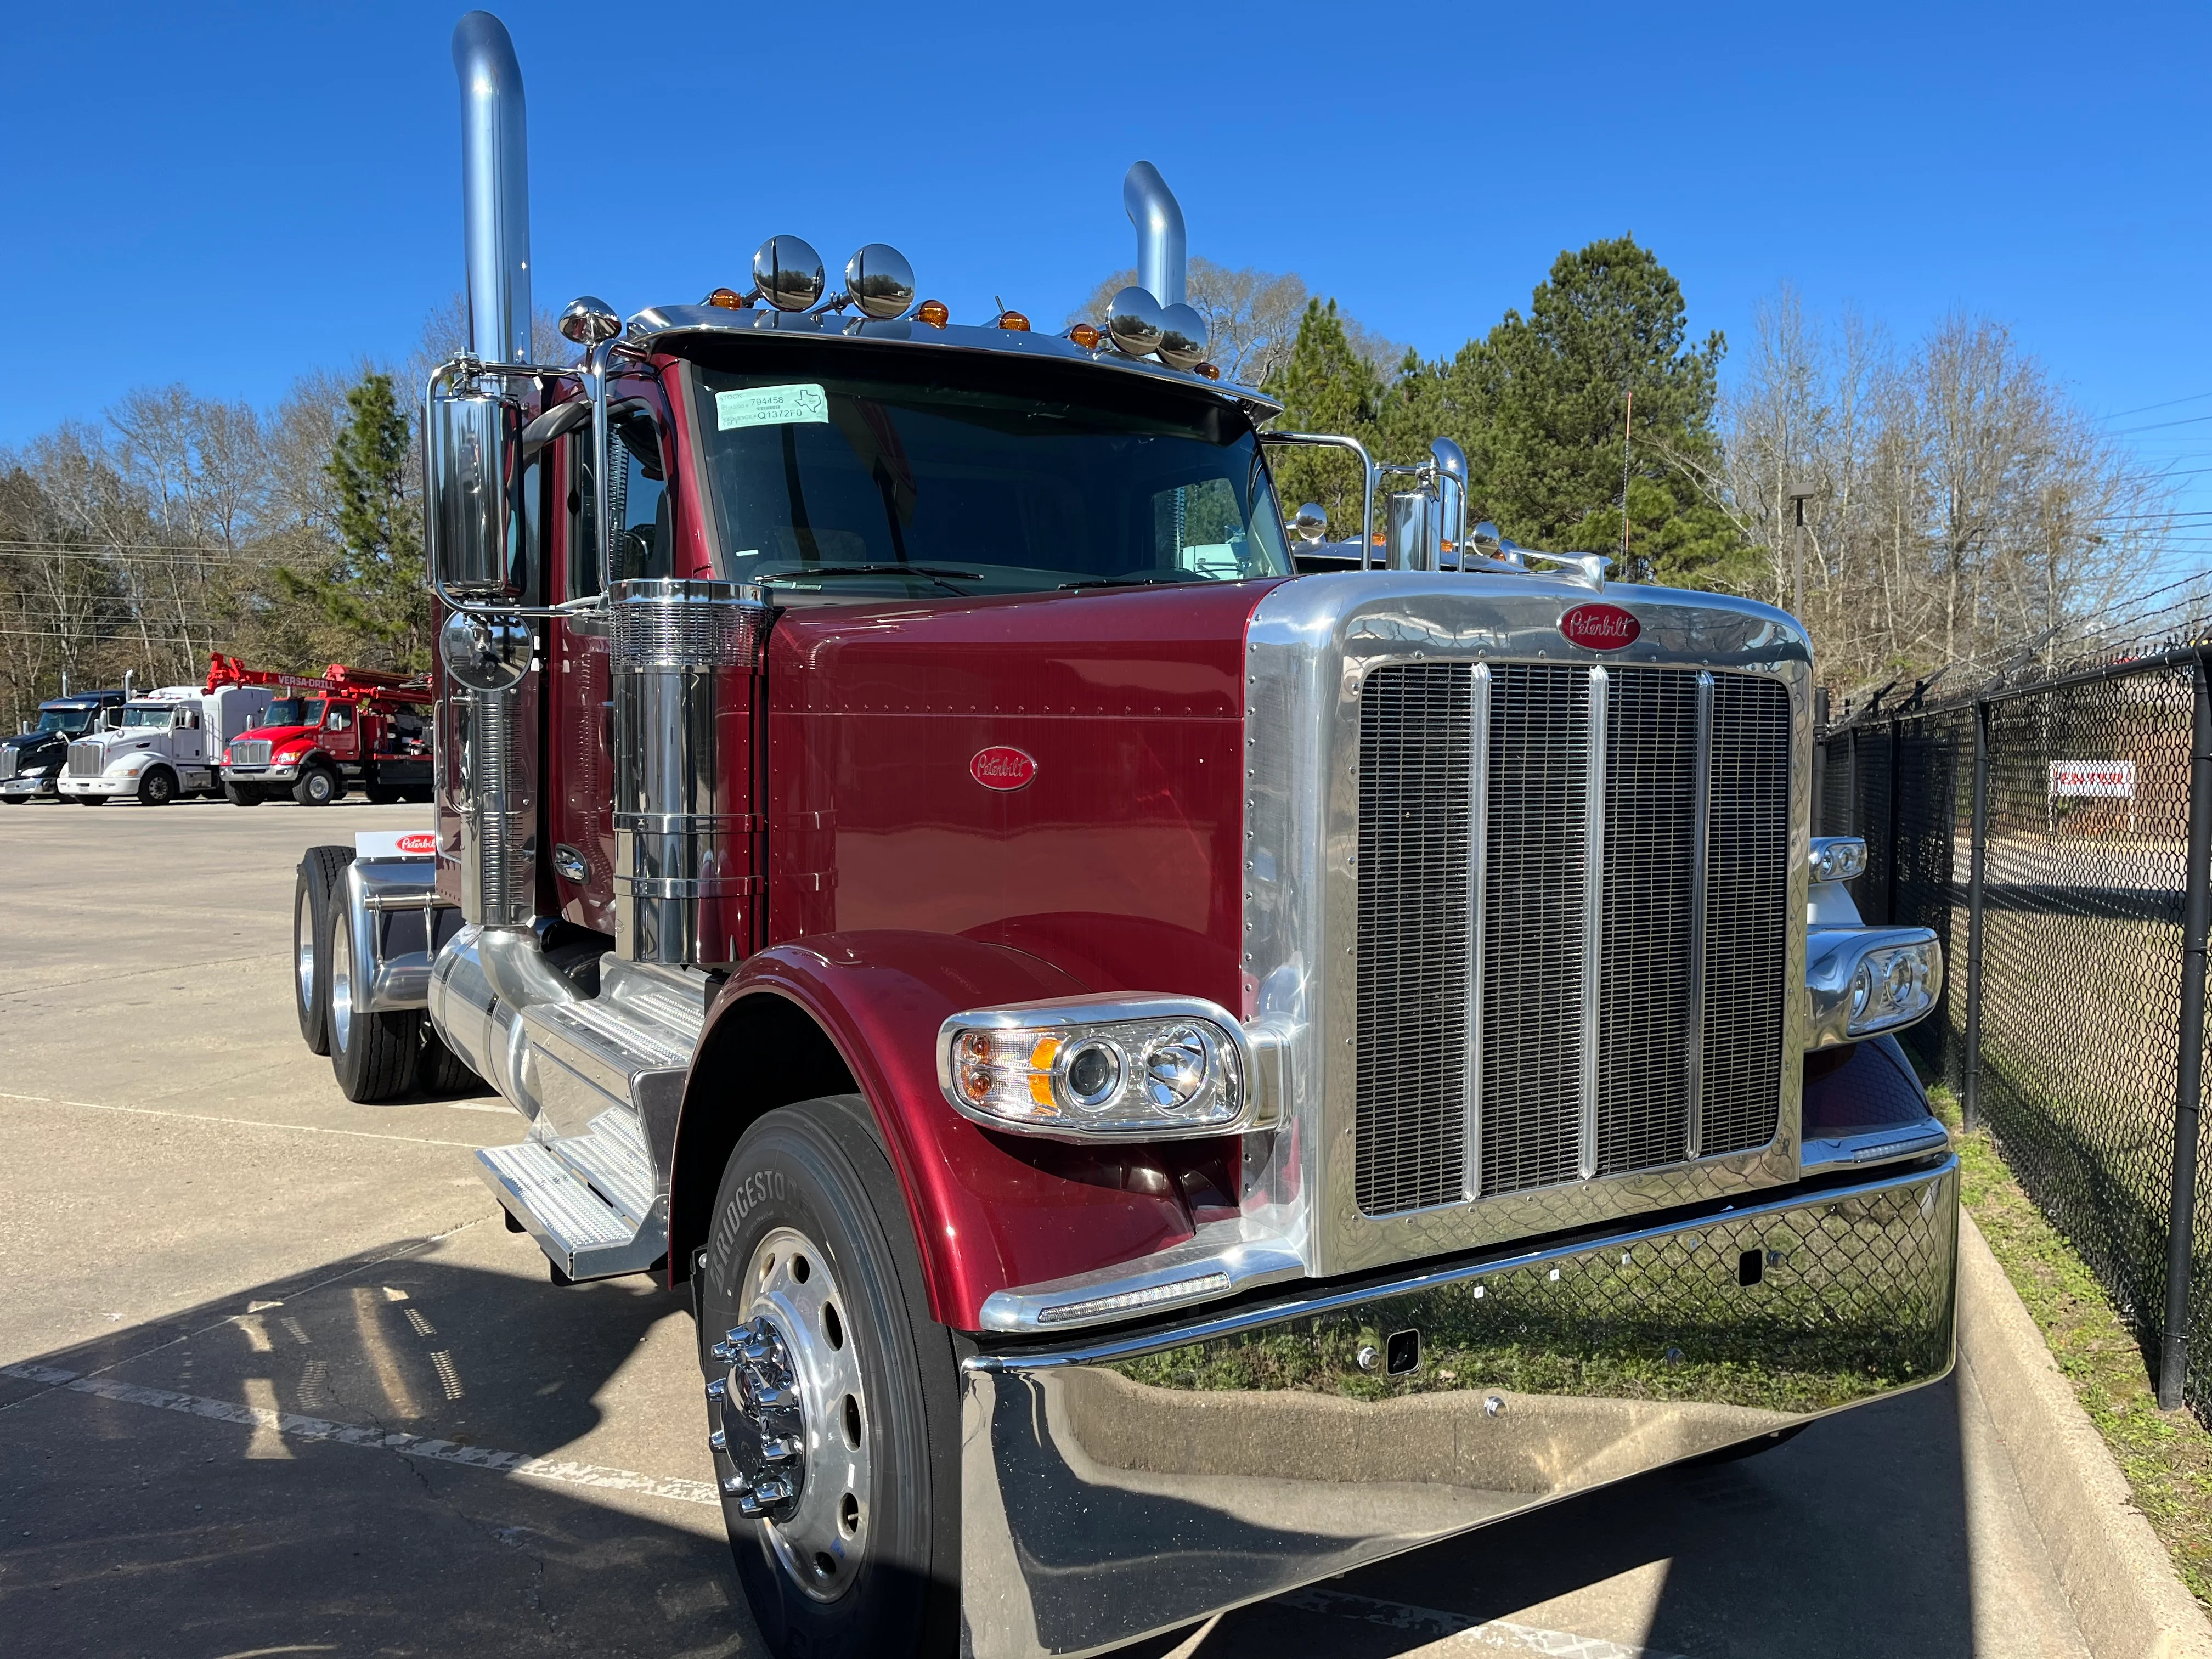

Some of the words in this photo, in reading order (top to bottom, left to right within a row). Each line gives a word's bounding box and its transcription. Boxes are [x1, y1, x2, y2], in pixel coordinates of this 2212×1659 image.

[751, 397, 784, 406] 794458
[758, 409, 802, 420] Q1372F0
[1570, 611, 1635, 637] Peterbilt
[278, 675, 335, 690] VERSA-DRILL
[977, 754, 1029, 777] Peterbilt
[400, 837, 436, 850] Peterbil
